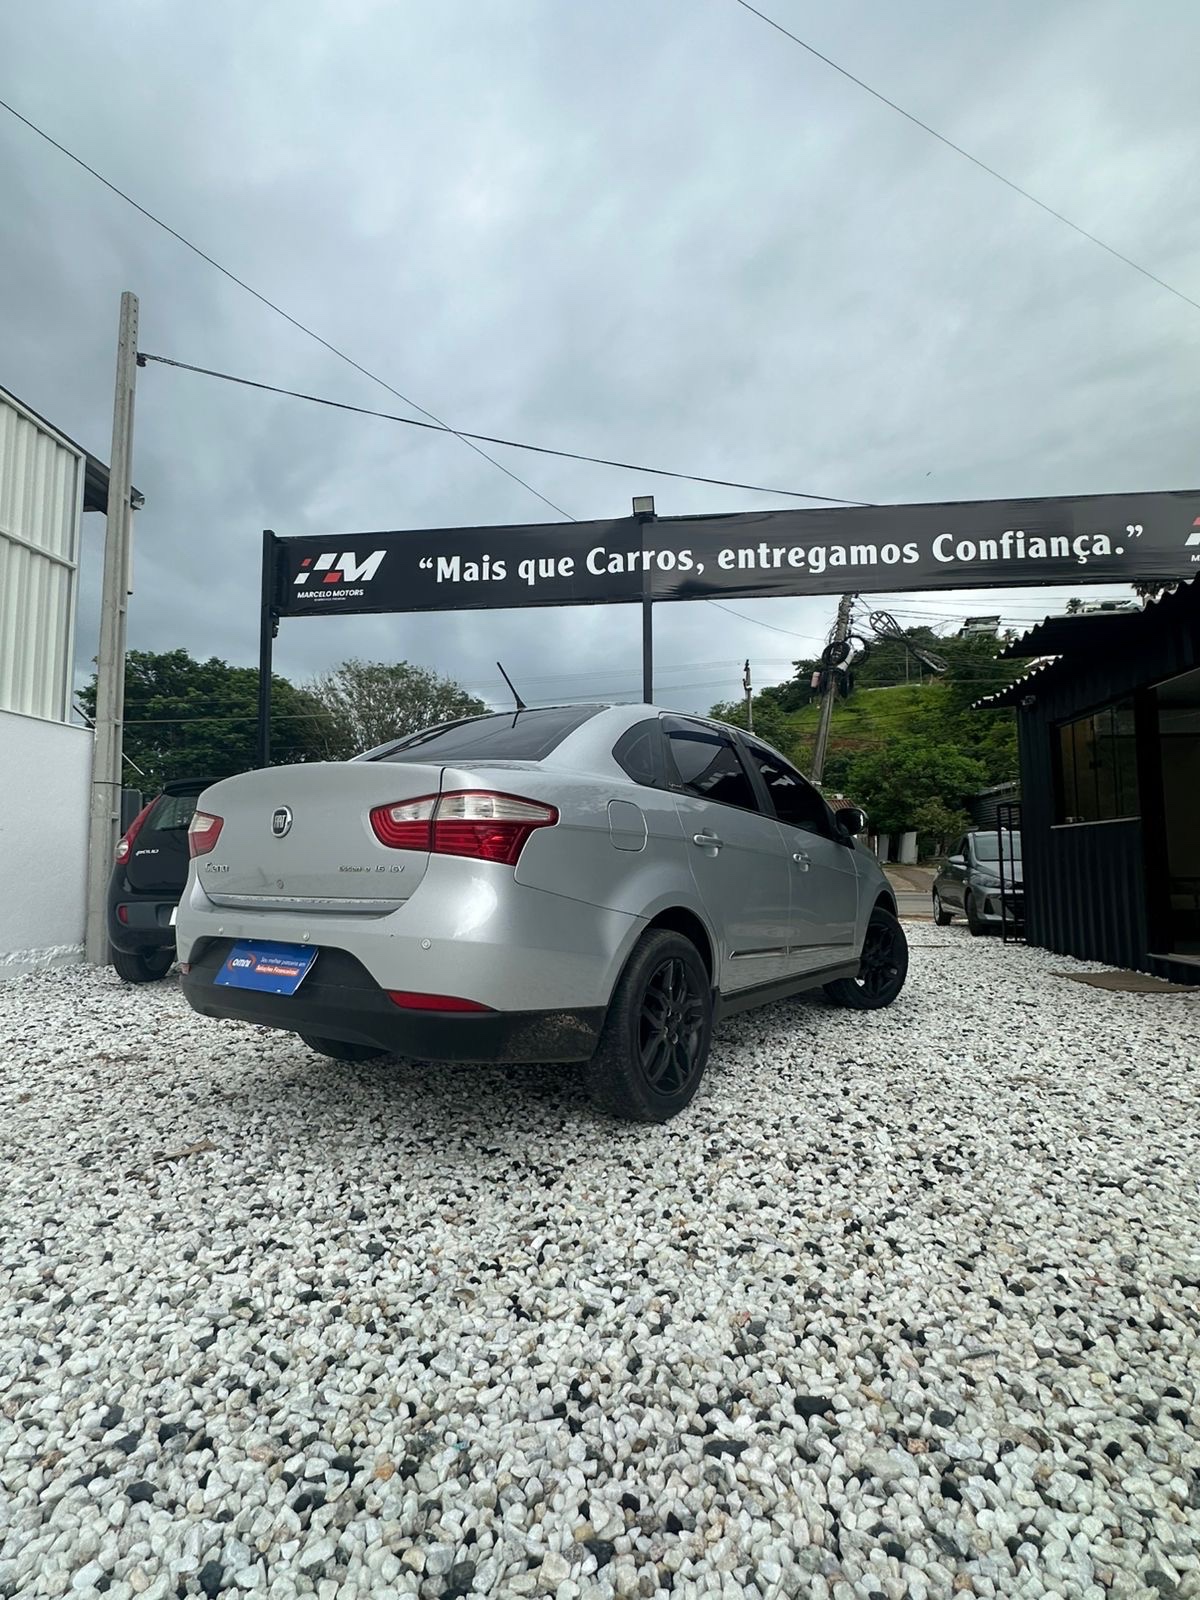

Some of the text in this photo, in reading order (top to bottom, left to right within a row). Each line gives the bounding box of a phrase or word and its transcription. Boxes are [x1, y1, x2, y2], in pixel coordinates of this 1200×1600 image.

[419, 524, 1144, 586] “Mais que Carros, entregamos Confiança.”
[297, 589, 364, 599] MARCELO MOTORS
